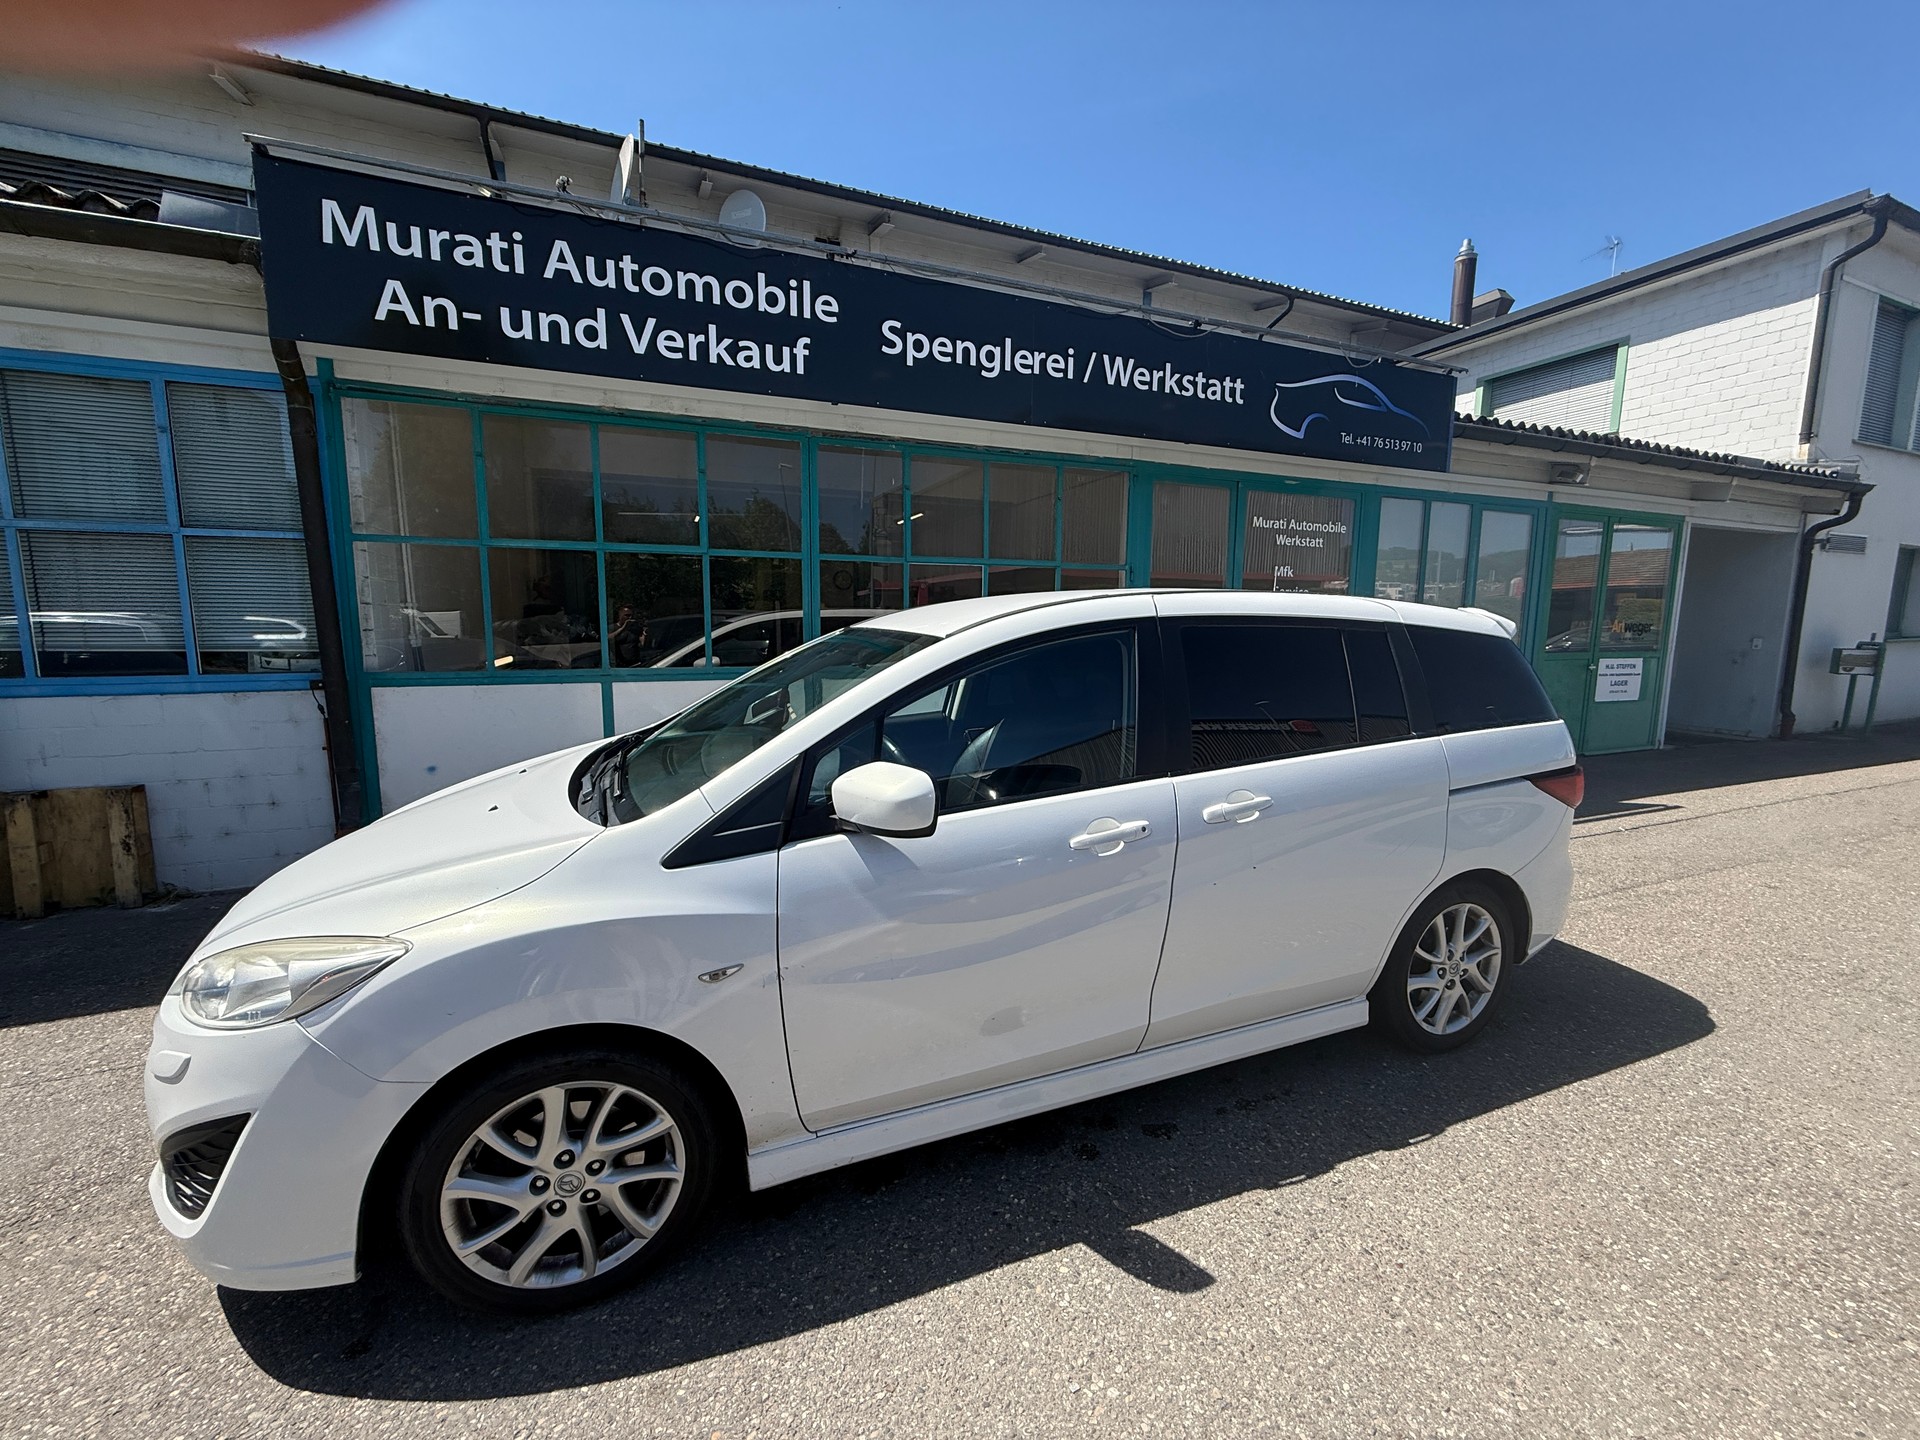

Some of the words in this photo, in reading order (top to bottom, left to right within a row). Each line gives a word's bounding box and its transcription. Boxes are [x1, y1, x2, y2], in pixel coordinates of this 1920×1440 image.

[321, 198, 525, 275] Murati
[543, 239, 839, 323] Automobile
[374, 279, 482, 331] An-
[500, 306, 608, 350] und
[619, 313, 811, 375] Verkauf
[881, 319, 1075, 380] Spenglerei
[1083, 351, 1097, 383] /
[1102, 354, 1246, 405] Werkstatt
[1340, 432, 1354, 445] Tel.
[1356, 435, 1371, 447] +41
[1373, 437, 1384, 448] 76
[1385, 438, 1400, 451] 513
[1401, 440, 1411, 451] 97
[1413, 442, 1423, 453] 10
[1252, 516, 1287, 529] Murati
[1288, 519, 1347, 533] Automobile
[1275, 534, 1324, 548] Werkstatt
[1274, 565, 1294, 578] Mfk
